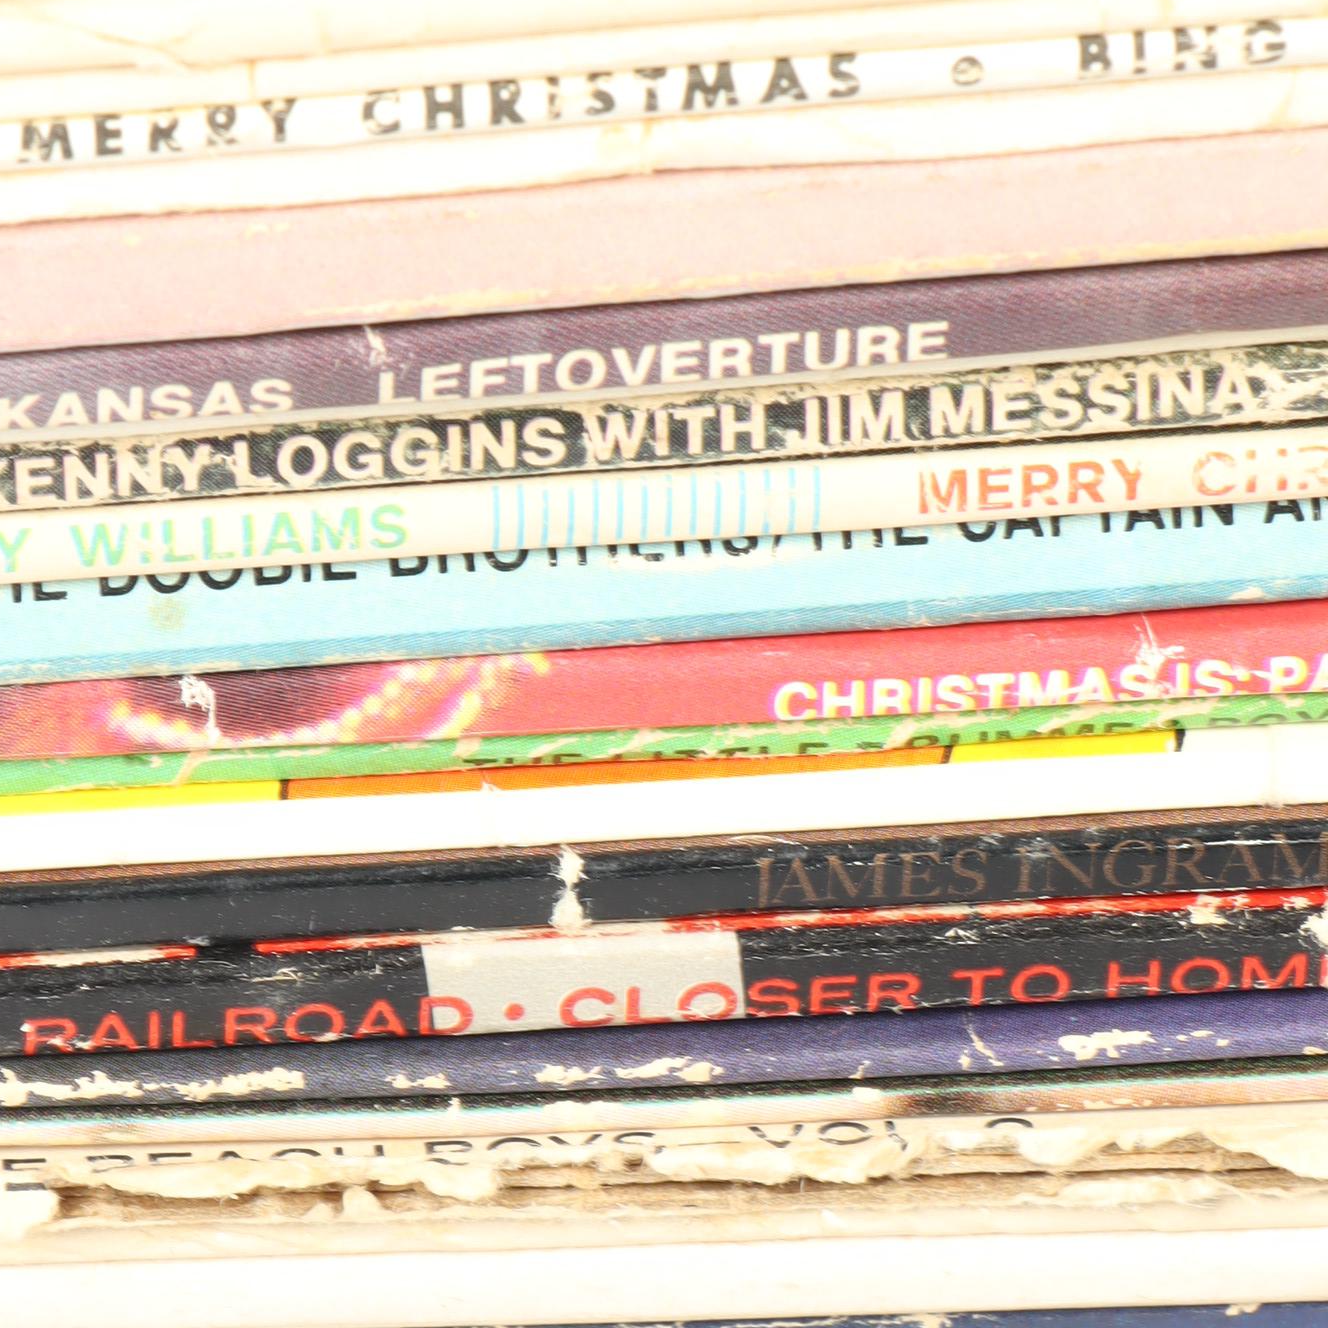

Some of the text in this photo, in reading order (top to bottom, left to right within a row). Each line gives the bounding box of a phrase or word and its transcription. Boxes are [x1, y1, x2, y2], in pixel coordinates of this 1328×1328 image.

[17, 96, 298, 163] MERRY
[362, 50, 862, 136] CHRISTMAS
[1077, 18, 1288, 81] BING
[376, 320, 950, 405] LEFTOVERTURE
[234, 416, 568, 491] LOGGINS
[583, 401, 770, 465] WITH
[784, 387, 909, 446] JIM
[929, 362, 1256, 438] MESSINA
[70, 502, 410, 569] WILLIAMS
[918, 457, 1146, 514] MERRY
[772, 660, 1156, 723] CHRISTMAS
[756, 845, 987, 910] JAMES
[1013, 828, 1328, 895] INGRAM
[25, 993, 475, 1058] RAILROAD
[558, 972, 923, 1029] CLOSER
[953, 964, 1073, 1008] TO
